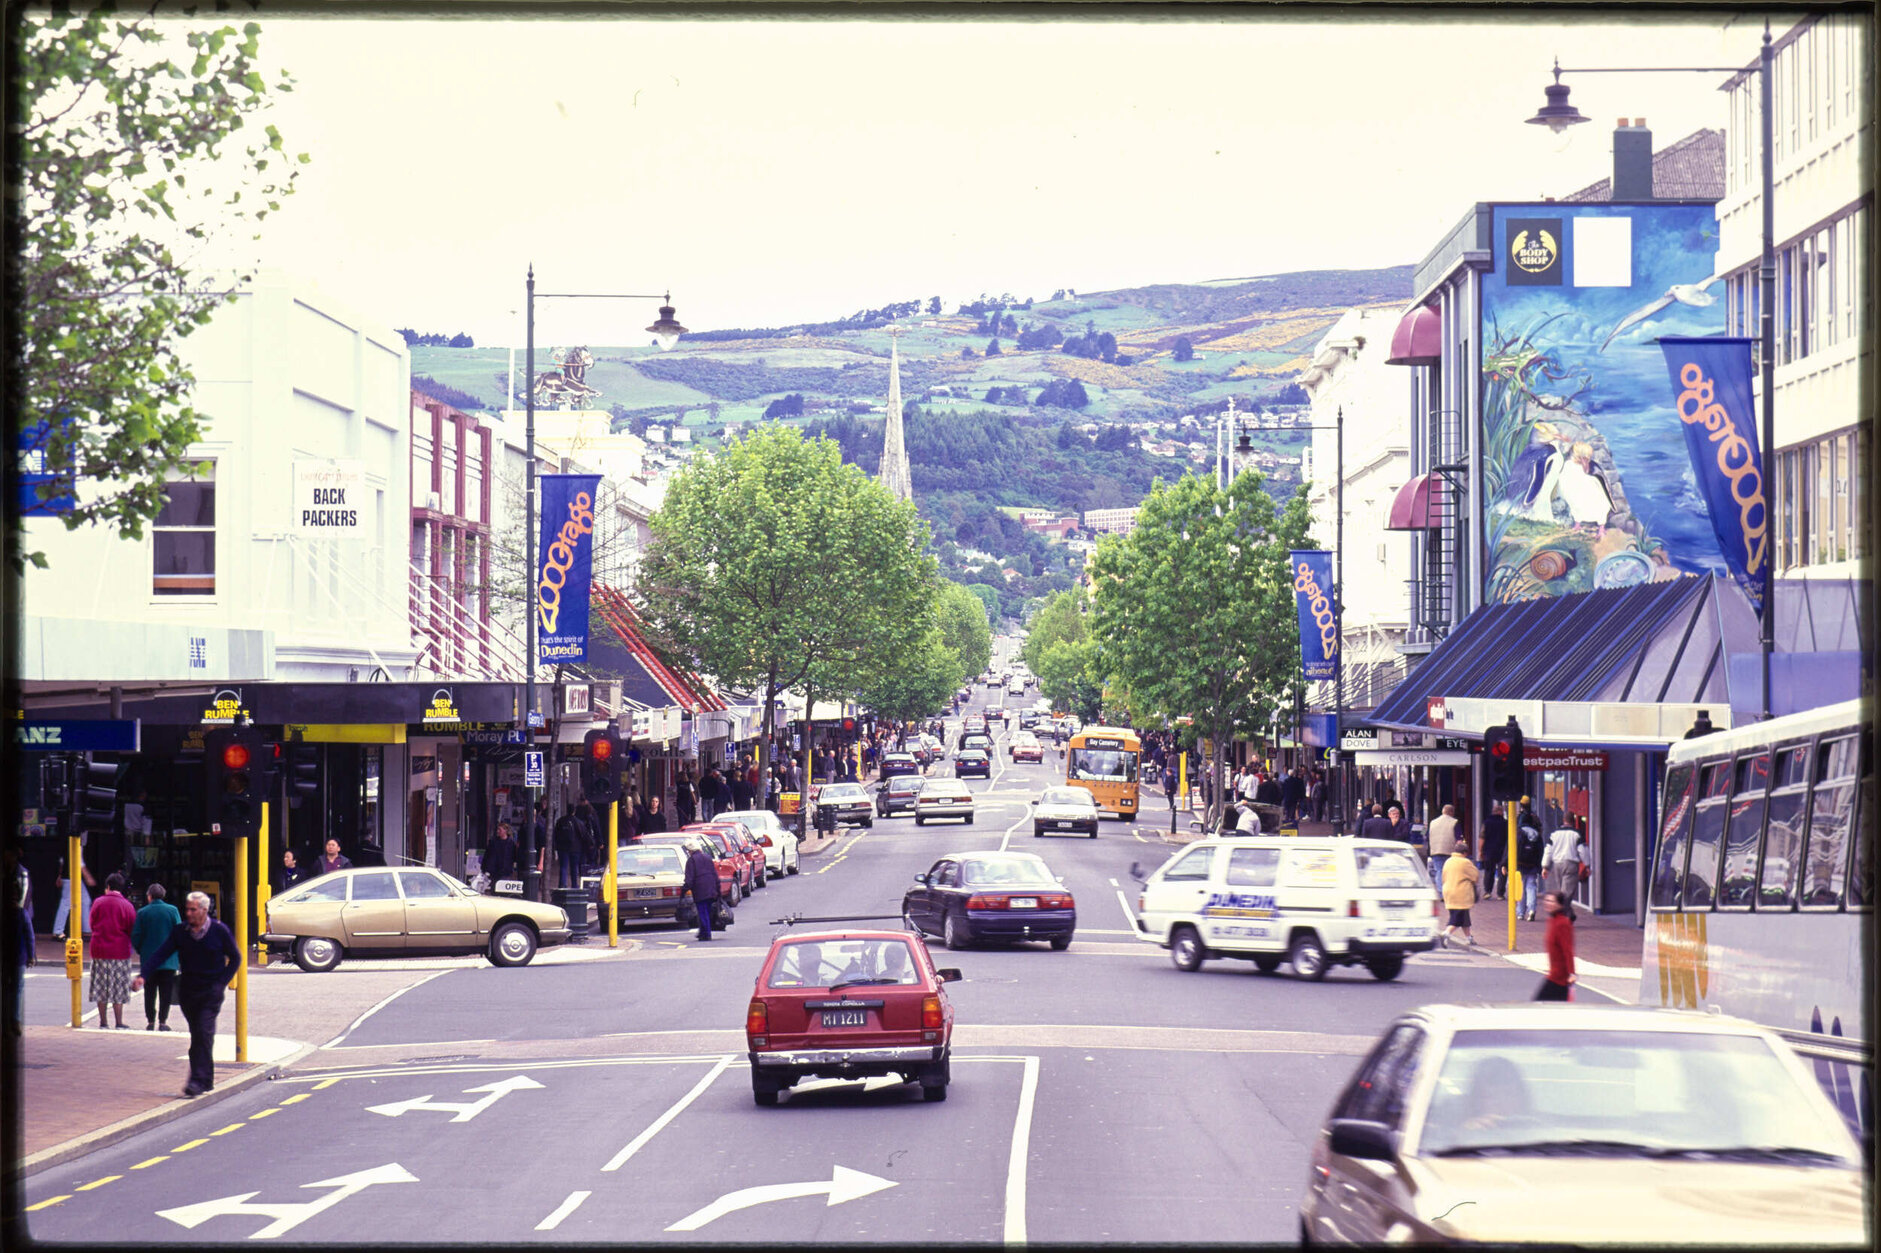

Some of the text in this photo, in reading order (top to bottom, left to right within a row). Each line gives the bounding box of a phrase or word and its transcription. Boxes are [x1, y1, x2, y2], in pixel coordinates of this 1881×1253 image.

[1520, 249, 1548, 257] BODY
[1521, 256, 1548, 265] SHOP
[313, 488, 345, 504] BACK
[302, 510, 356, 526] PACKERS
[541, 643, 583, 657] Dunedin
[216, 700, 239, 709] BEN
[434, 699, 451, 708] BEN
[204, 710, 250, 719] RUMBE
[425, 708, 458, 718] RUMBLE
[423, 721, 485, 732] RUMBLE
[17, 727, 62, 744] ANZ
[467, 731, 520, 744] Moray Pl
[1345, 730, 1372, 738] ALAN
[1389, 754, 1438, 762] CARLSON
[1522, 756, 1603, 767] estpacTrust
[505, 883, 523, 891] OPE
[841, 1012, 864, 1024] 1211
